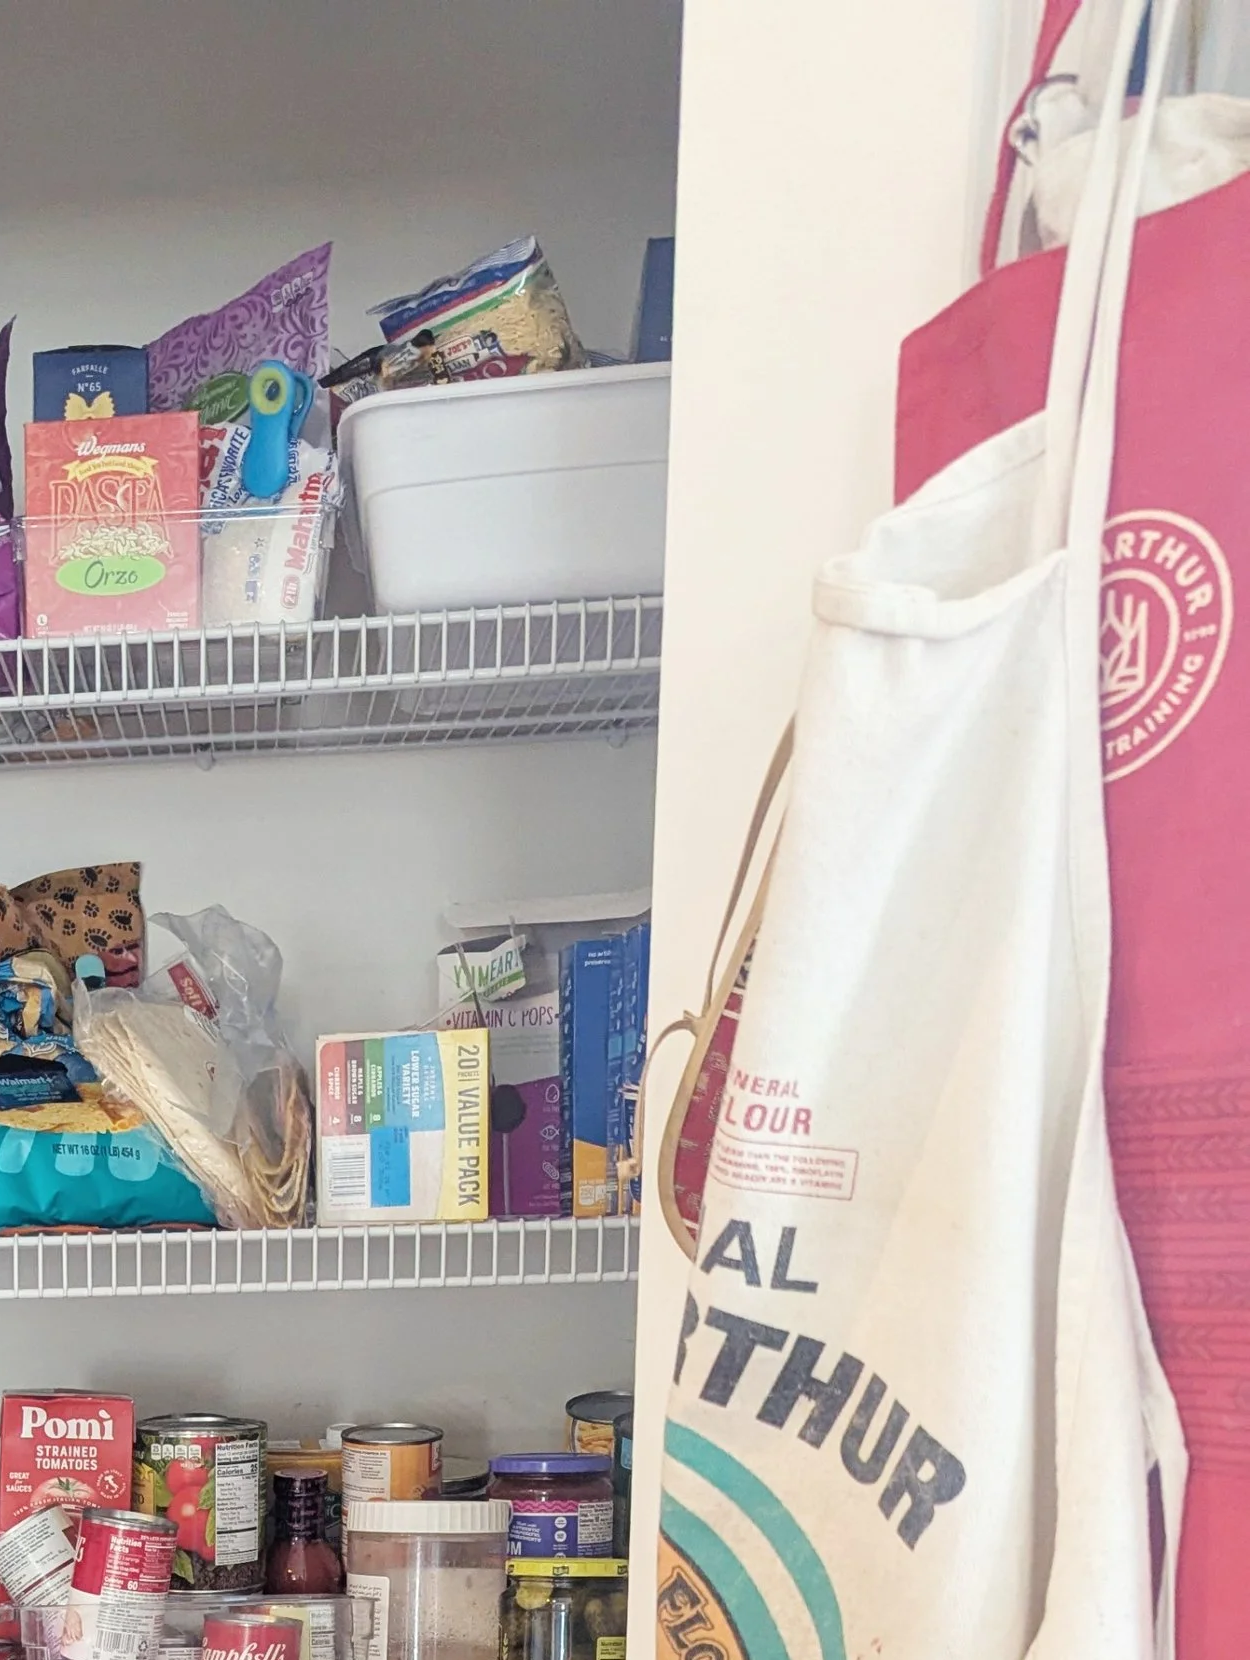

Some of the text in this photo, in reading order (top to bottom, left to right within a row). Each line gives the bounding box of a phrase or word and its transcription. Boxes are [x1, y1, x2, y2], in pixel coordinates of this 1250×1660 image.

[71, 364, 108, 376] FARFALLE
[76, 435, 146, 461] Wegmans
[50, 474, 174, 564] PASTA
[84, 560, 138, 588] Orzo
[1105, 655, 1205, 760] TRAINING
[507, 1006, 554, 1027] C POPS
[402, 1063, 411, 1106] VARIETY
[411, 1050, 420, 1118] LOWER SUGAR
[457, 1044, 480, 1207] 20 VALUE PACK
[52, 1144, 66, 1155] NET
[66, 1144, 80, 1155] WT
[80, 1144, 89, 1155] 16
[121, 1147, 134, 1158] 454
[20, 1405, 115, 1440] Pomì
[36, 1445, 98, 1458] STRAINED
[216, 1443, 244, 1451] Nutrition
[35, 1457, 98, 1471] TOMATOES
[250, 1463, 258, 1473] 25
[9, 1472, 30, 1480] GREAT
[6, 1484, 33, 1493] SAUCES
[110, 1544, 129, 1554] Facts
[111, 1536, 142, 1548] Nutrition
[127, 1580, 138, 1591] 60
